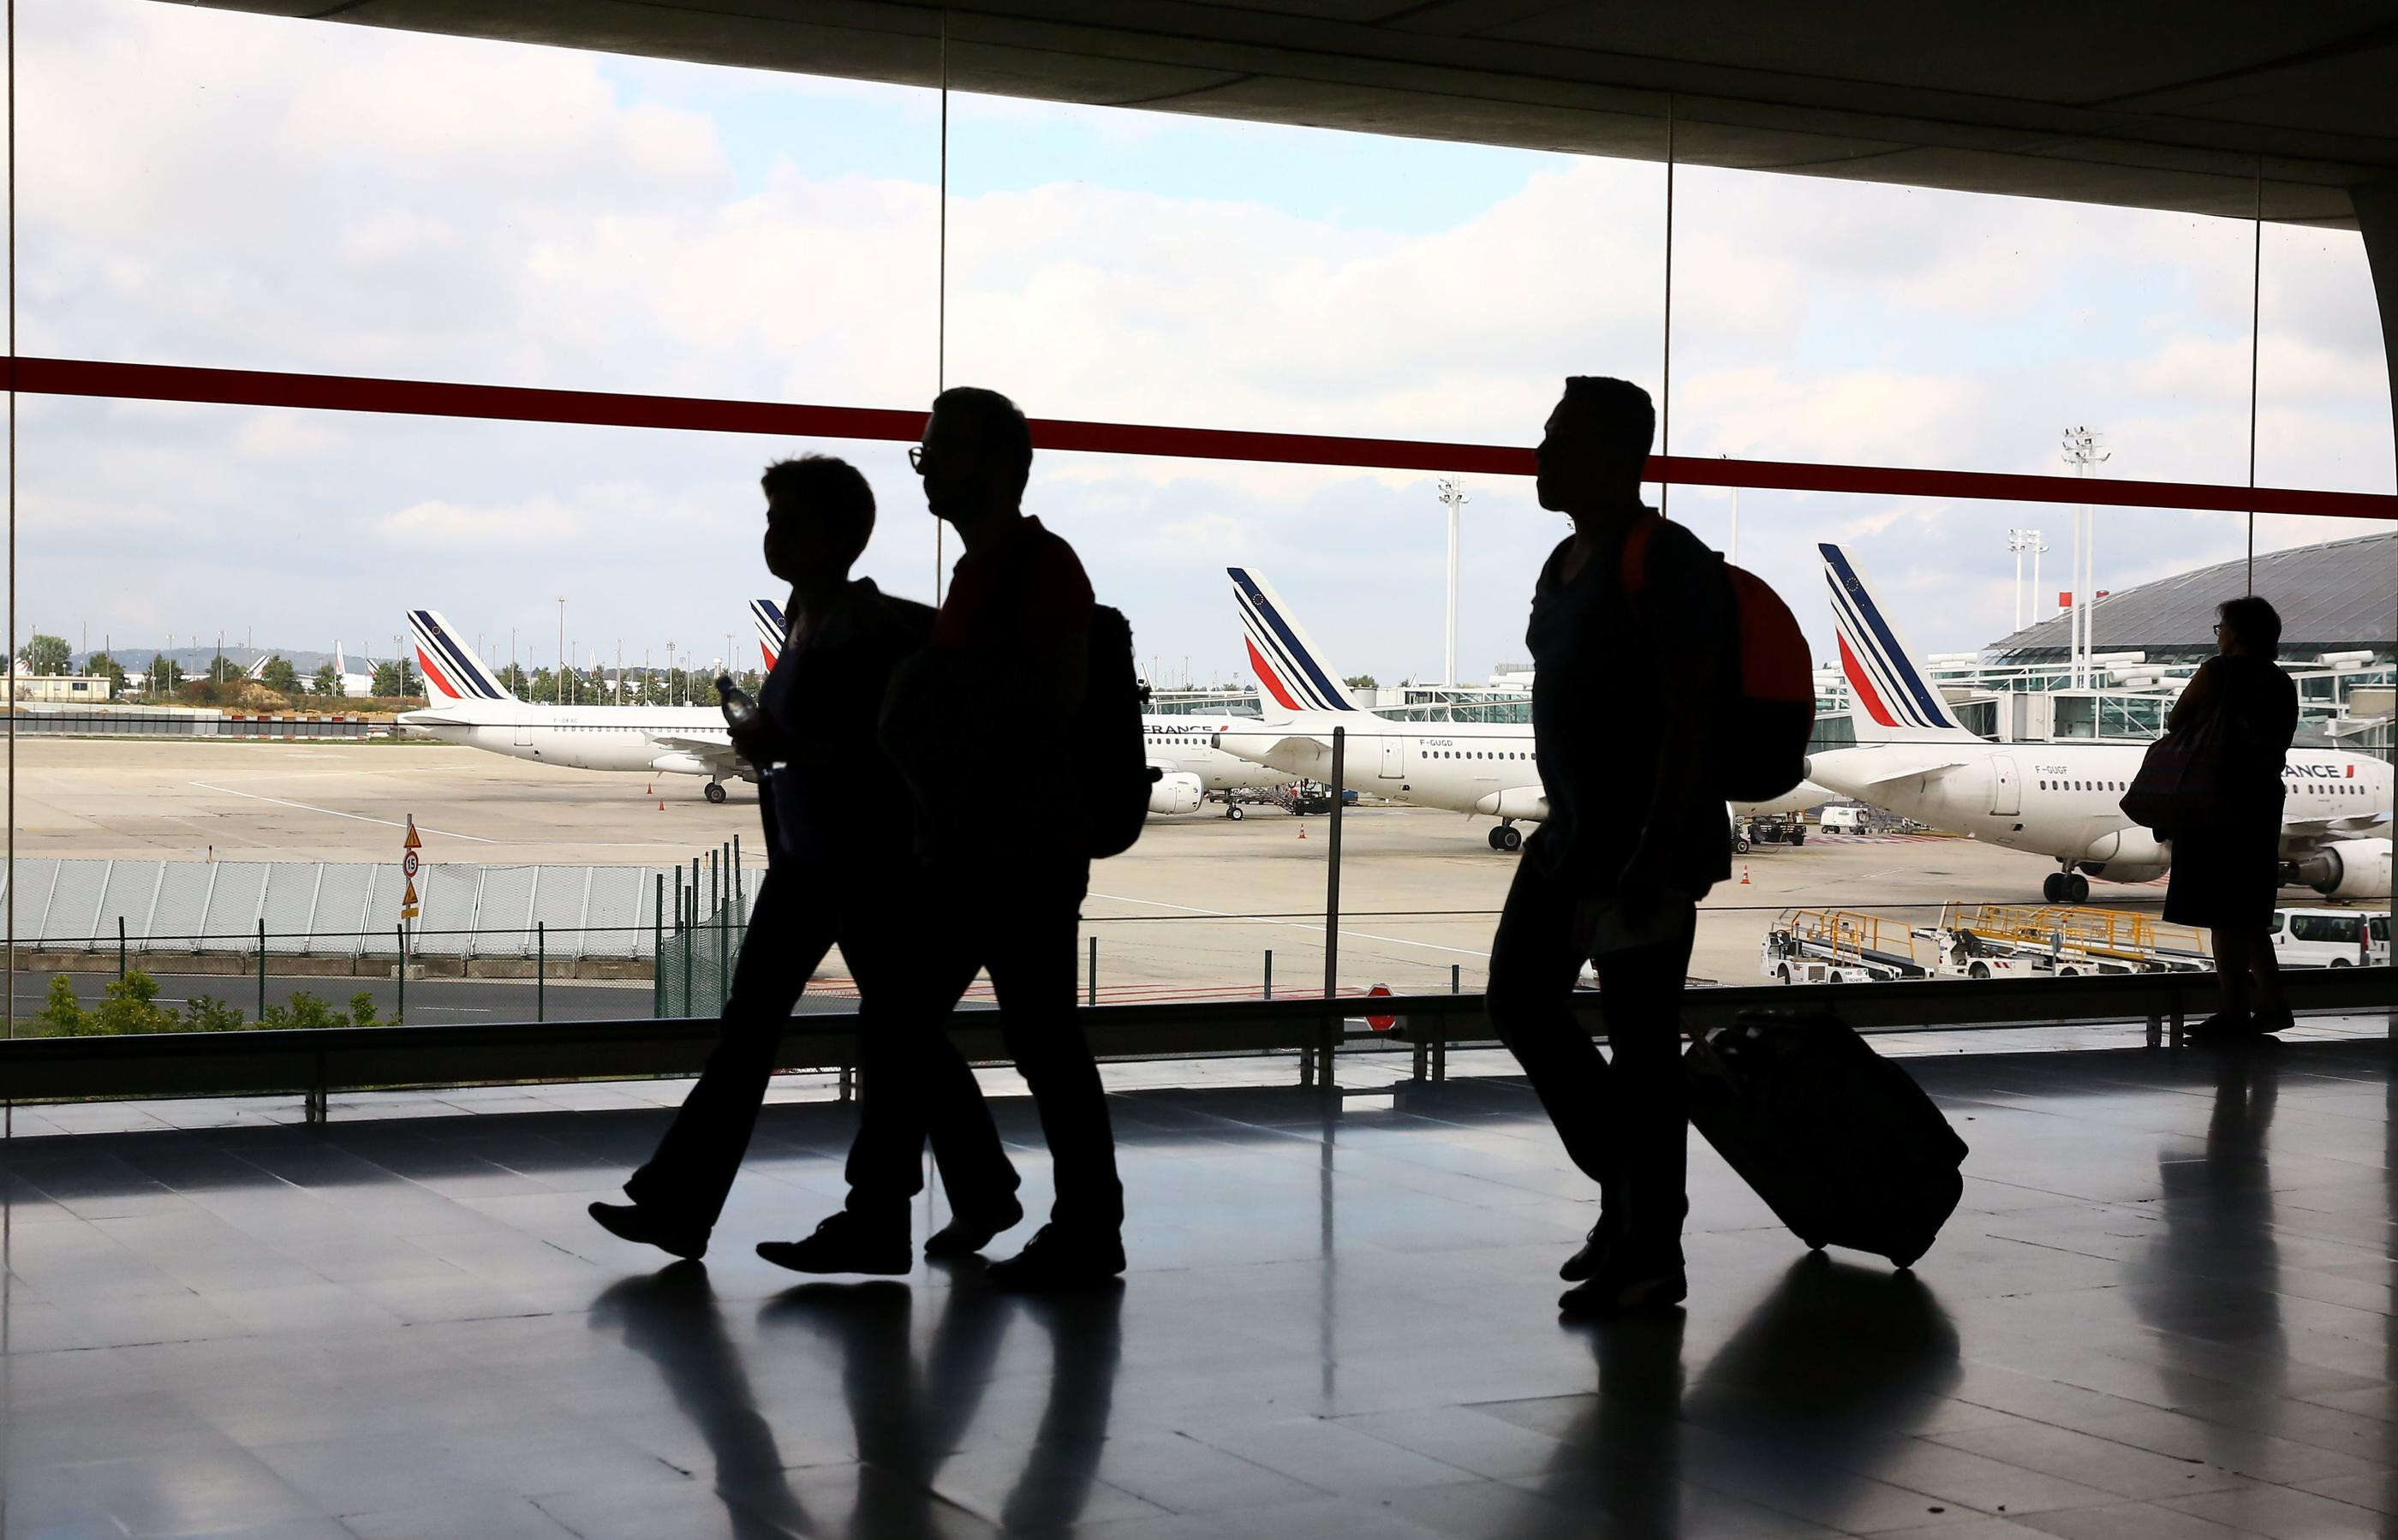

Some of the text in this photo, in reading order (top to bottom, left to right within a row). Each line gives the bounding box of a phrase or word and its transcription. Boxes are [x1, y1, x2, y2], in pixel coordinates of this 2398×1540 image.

[2034, 765, 2067, 774] F-GUGF
[2281, 765, 2341, 778] ANCE
[407, 858, 415, 870] 15
